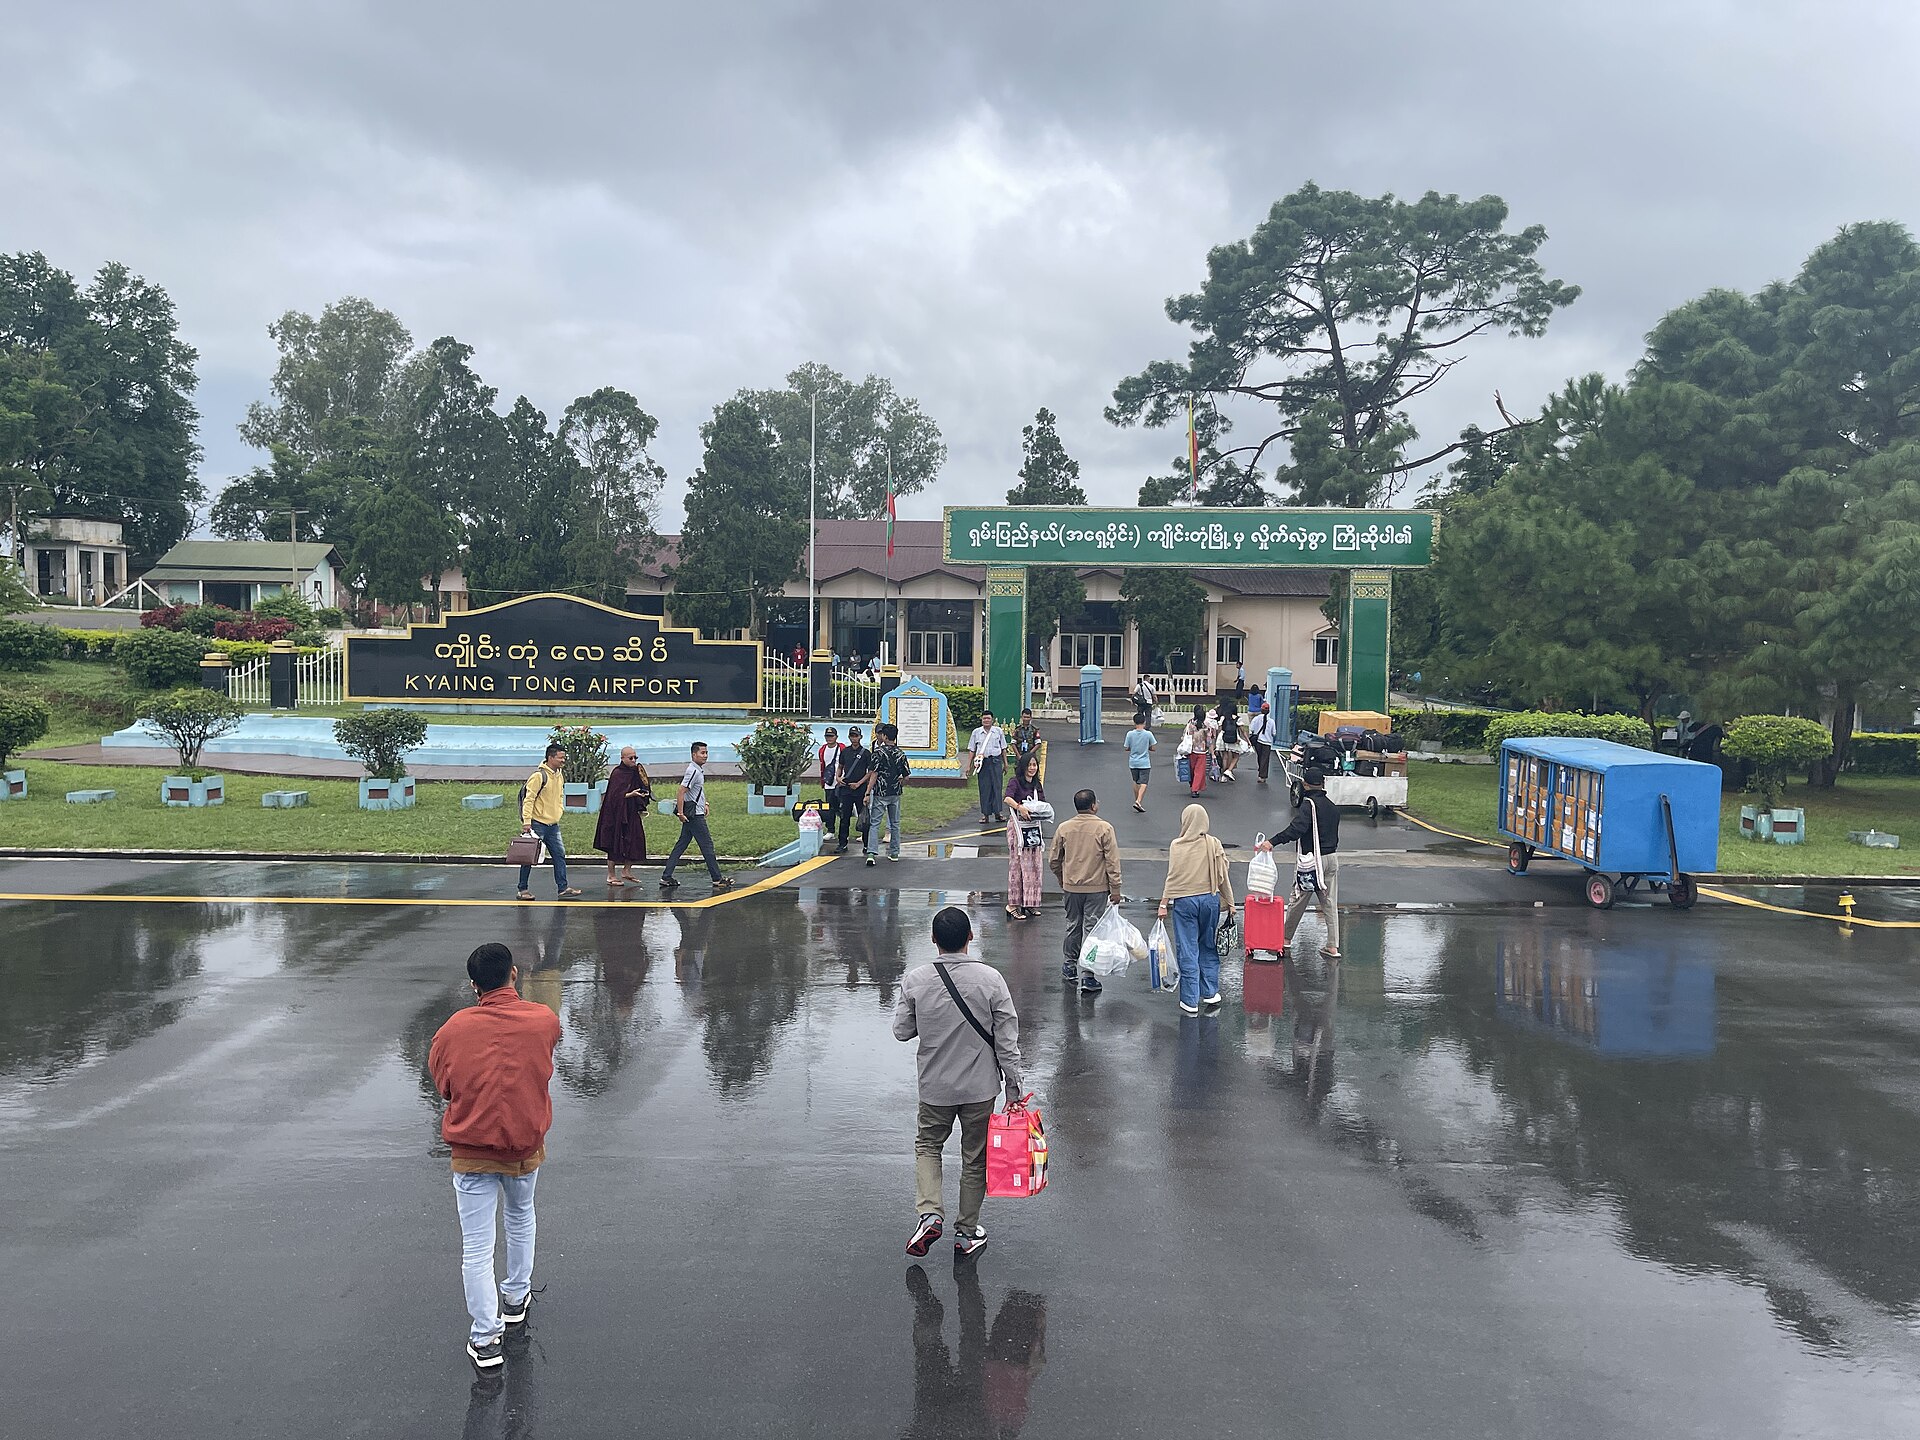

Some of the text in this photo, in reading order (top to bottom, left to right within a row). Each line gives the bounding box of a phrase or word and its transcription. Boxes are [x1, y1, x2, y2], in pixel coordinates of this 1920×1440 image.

[405, 674, 700, 695] KYAING TONG AIRPORT
